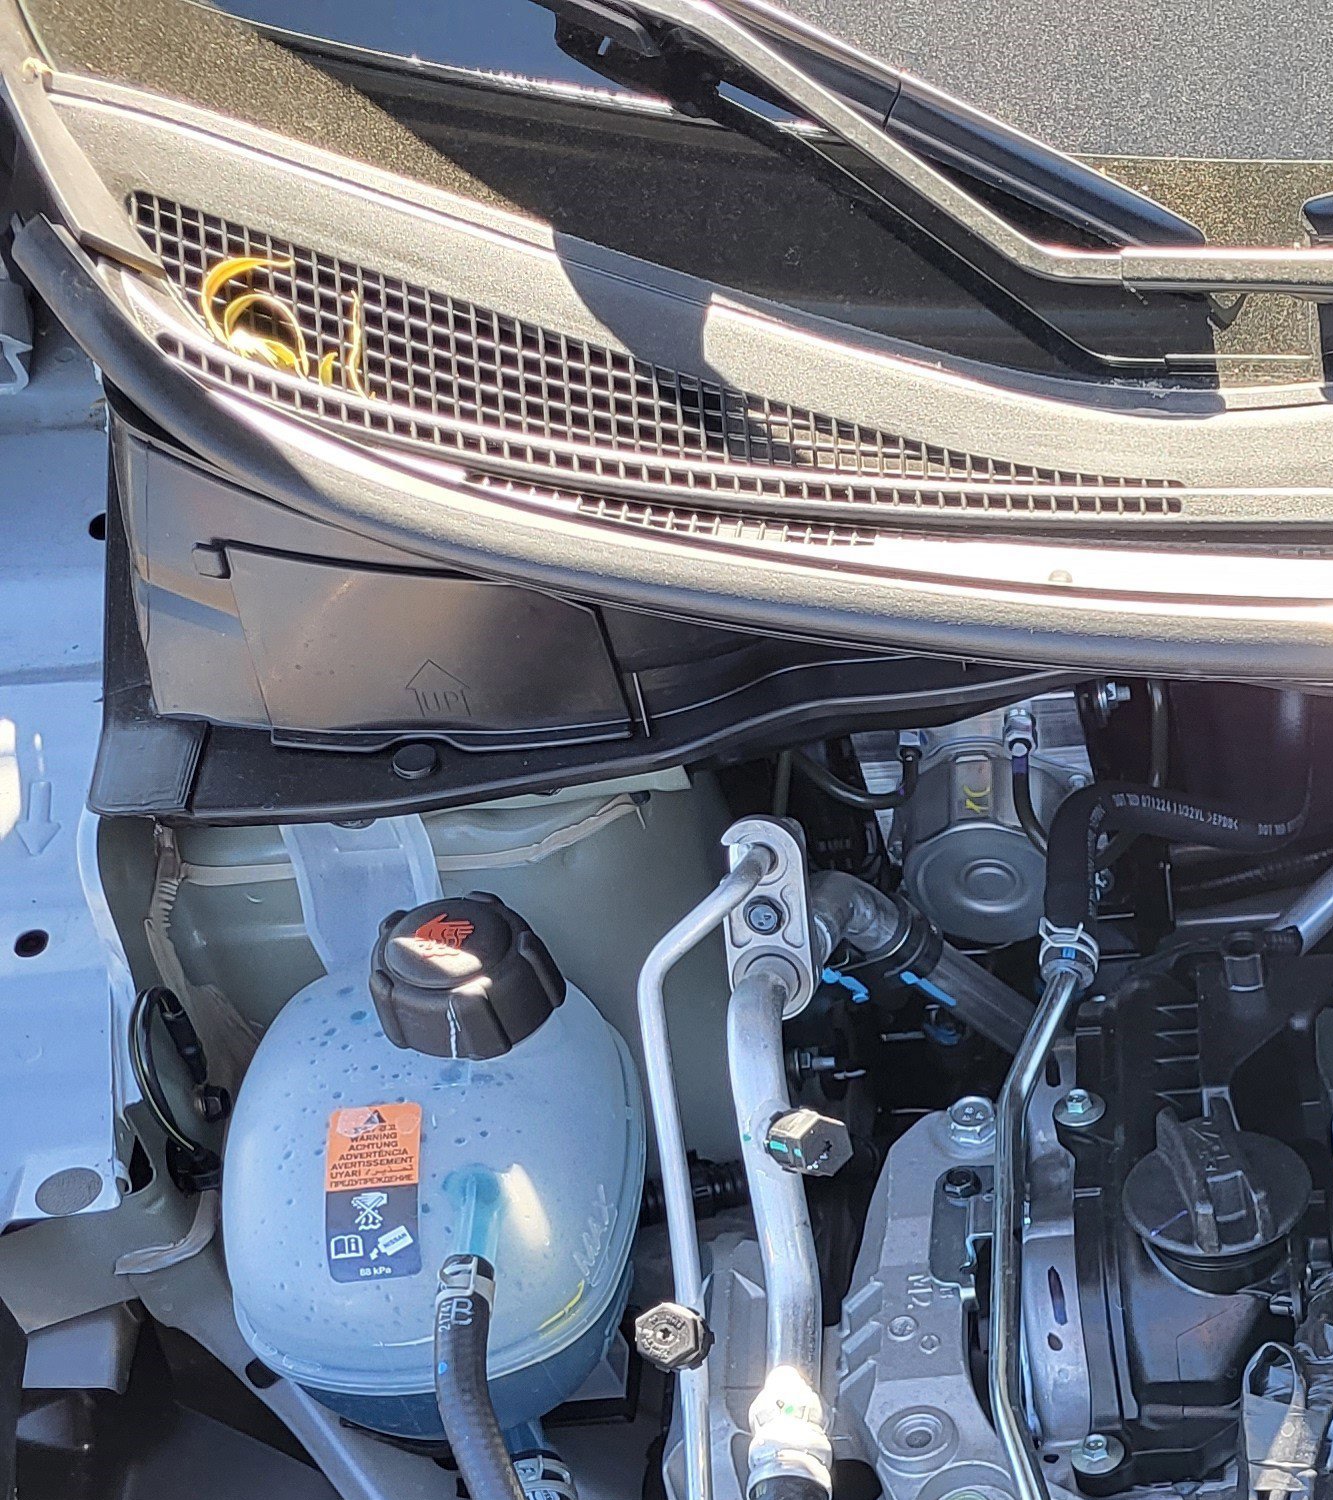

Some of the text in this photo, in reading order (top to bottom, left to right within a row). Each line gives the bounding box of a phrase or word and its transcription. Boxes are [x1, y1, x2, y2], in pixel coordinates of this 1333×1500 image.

[350, 1132, 397, 1142] WARNING
[348, 1141, 398, 1151] ACHTUNG
[331, 1156, 414, 1170] AVERTISSEMENT
